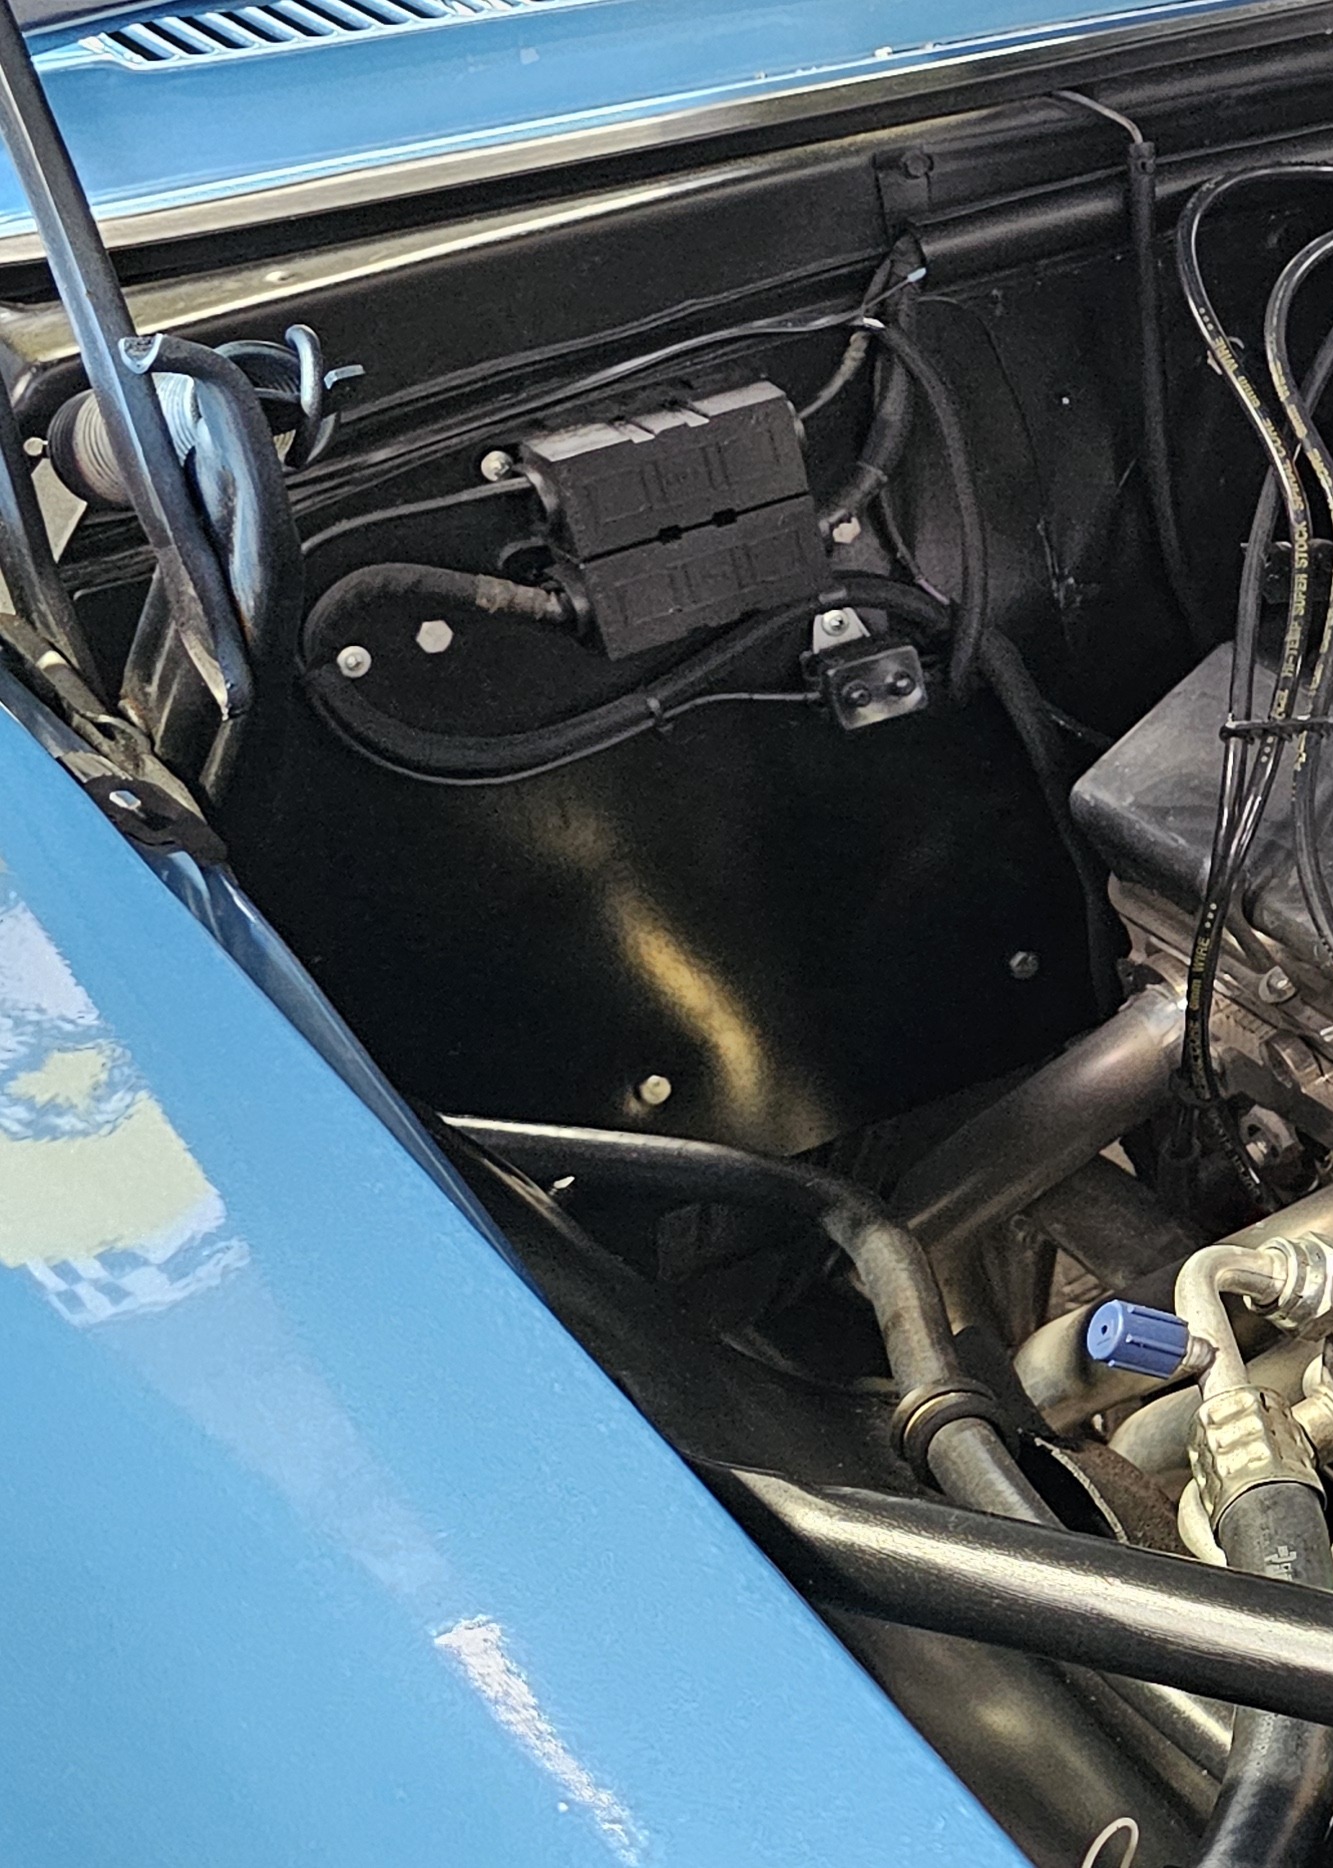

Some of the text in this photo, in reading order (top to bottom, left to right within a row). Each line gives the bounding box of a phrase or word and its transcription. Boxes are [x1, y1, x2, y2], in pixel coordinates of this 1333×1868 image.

[1209, 333, 1240, 375] WIRE
[1295, 520, 1307, 567] STOCK
[1292, 573, 1308, 615] SUPER
[1192, 936, 1210, 972] WIRE
